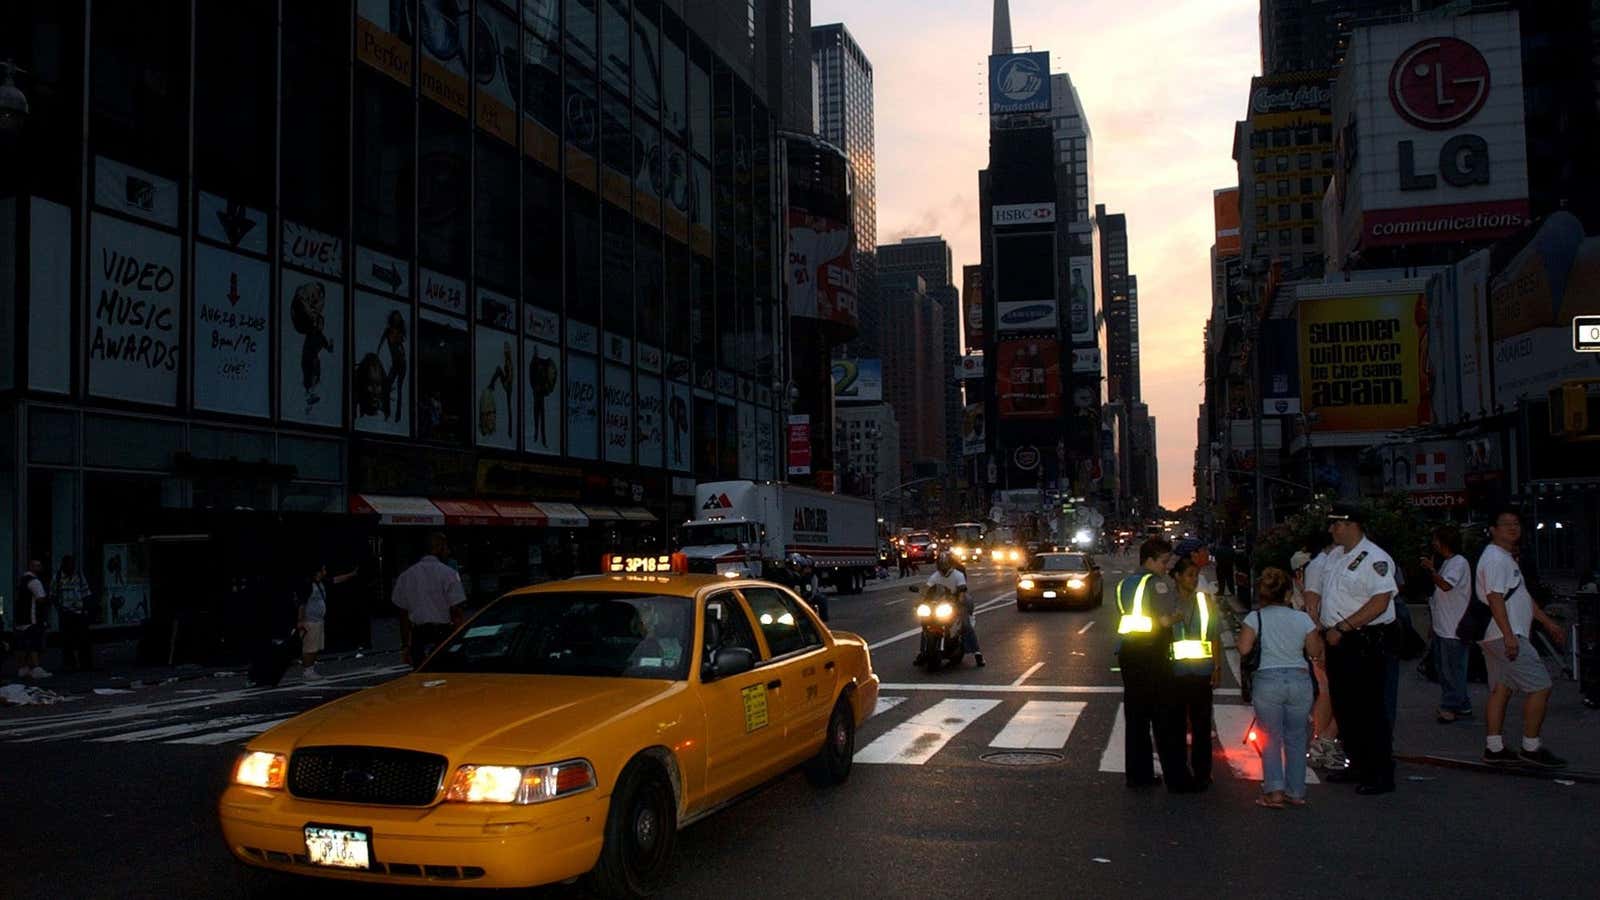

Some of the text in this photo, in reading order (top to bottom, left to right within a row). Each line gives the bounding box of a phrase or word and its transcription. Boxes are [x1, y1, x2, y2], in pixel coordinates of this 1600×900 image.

[993, 102, 1049, 112] Prudential
[1397, 134, 1490, 191] LG
[996, 208, 1031, 221] HSBC
[1372, 210, 1523, 237] communications
[292, 235, 341, 263] LIVE!
[102, 247, 175, 293] VIDEO
[96, 288, 173, 331] MUSIC
[1309, 318, 1401, 344] summer
[90, 325, 179, 372] AWARDS
[1310, 343, 1402, 365] will never
[1311, 362, 1402, 380] be the same
[1311, 379, 1408, 407] again.
[625, 557, 656, 572] 3P18
